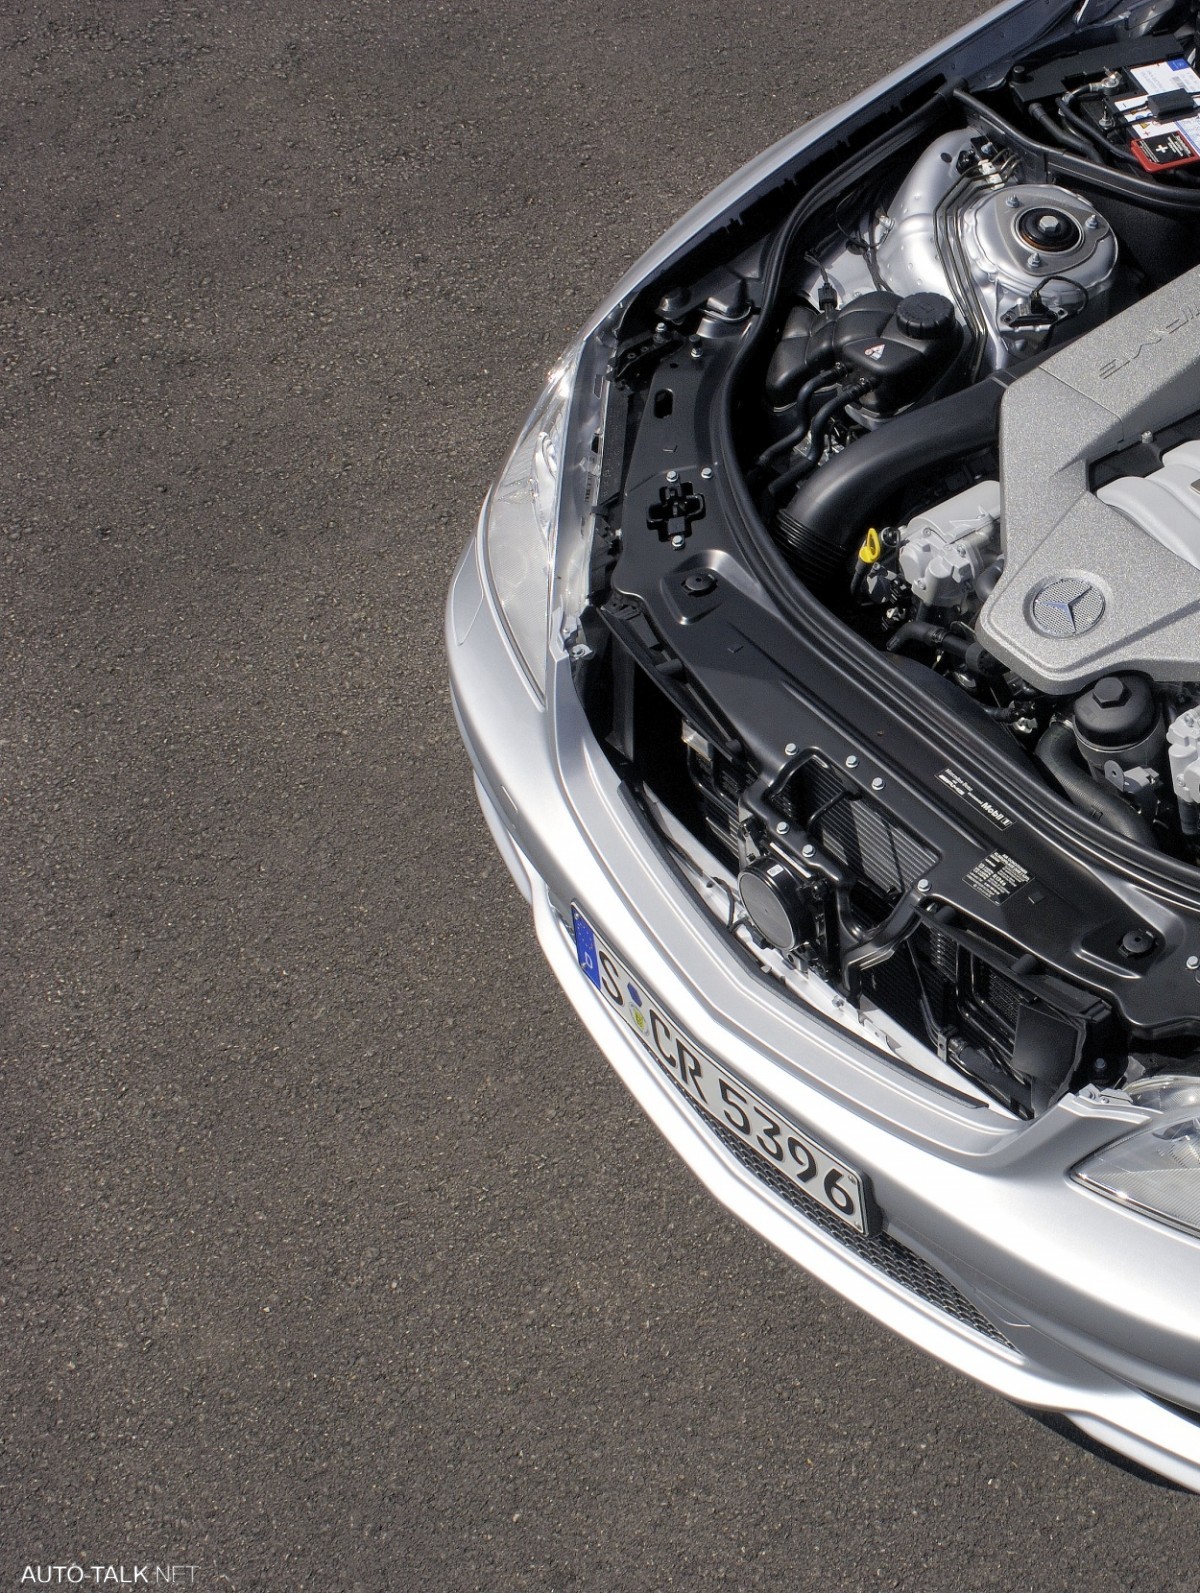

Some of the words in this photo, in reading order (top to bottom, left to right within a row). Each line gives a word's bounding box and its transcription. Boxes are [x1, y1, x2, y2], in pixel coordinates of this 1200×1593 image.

[980, 802, 1004, 821] Mobil
[584, 951, 594, 969] D
[599, 949, 624, 1007] S
[649, 1009, 709, 1104] CR
[718, 1077, 855, 1216] 5396
